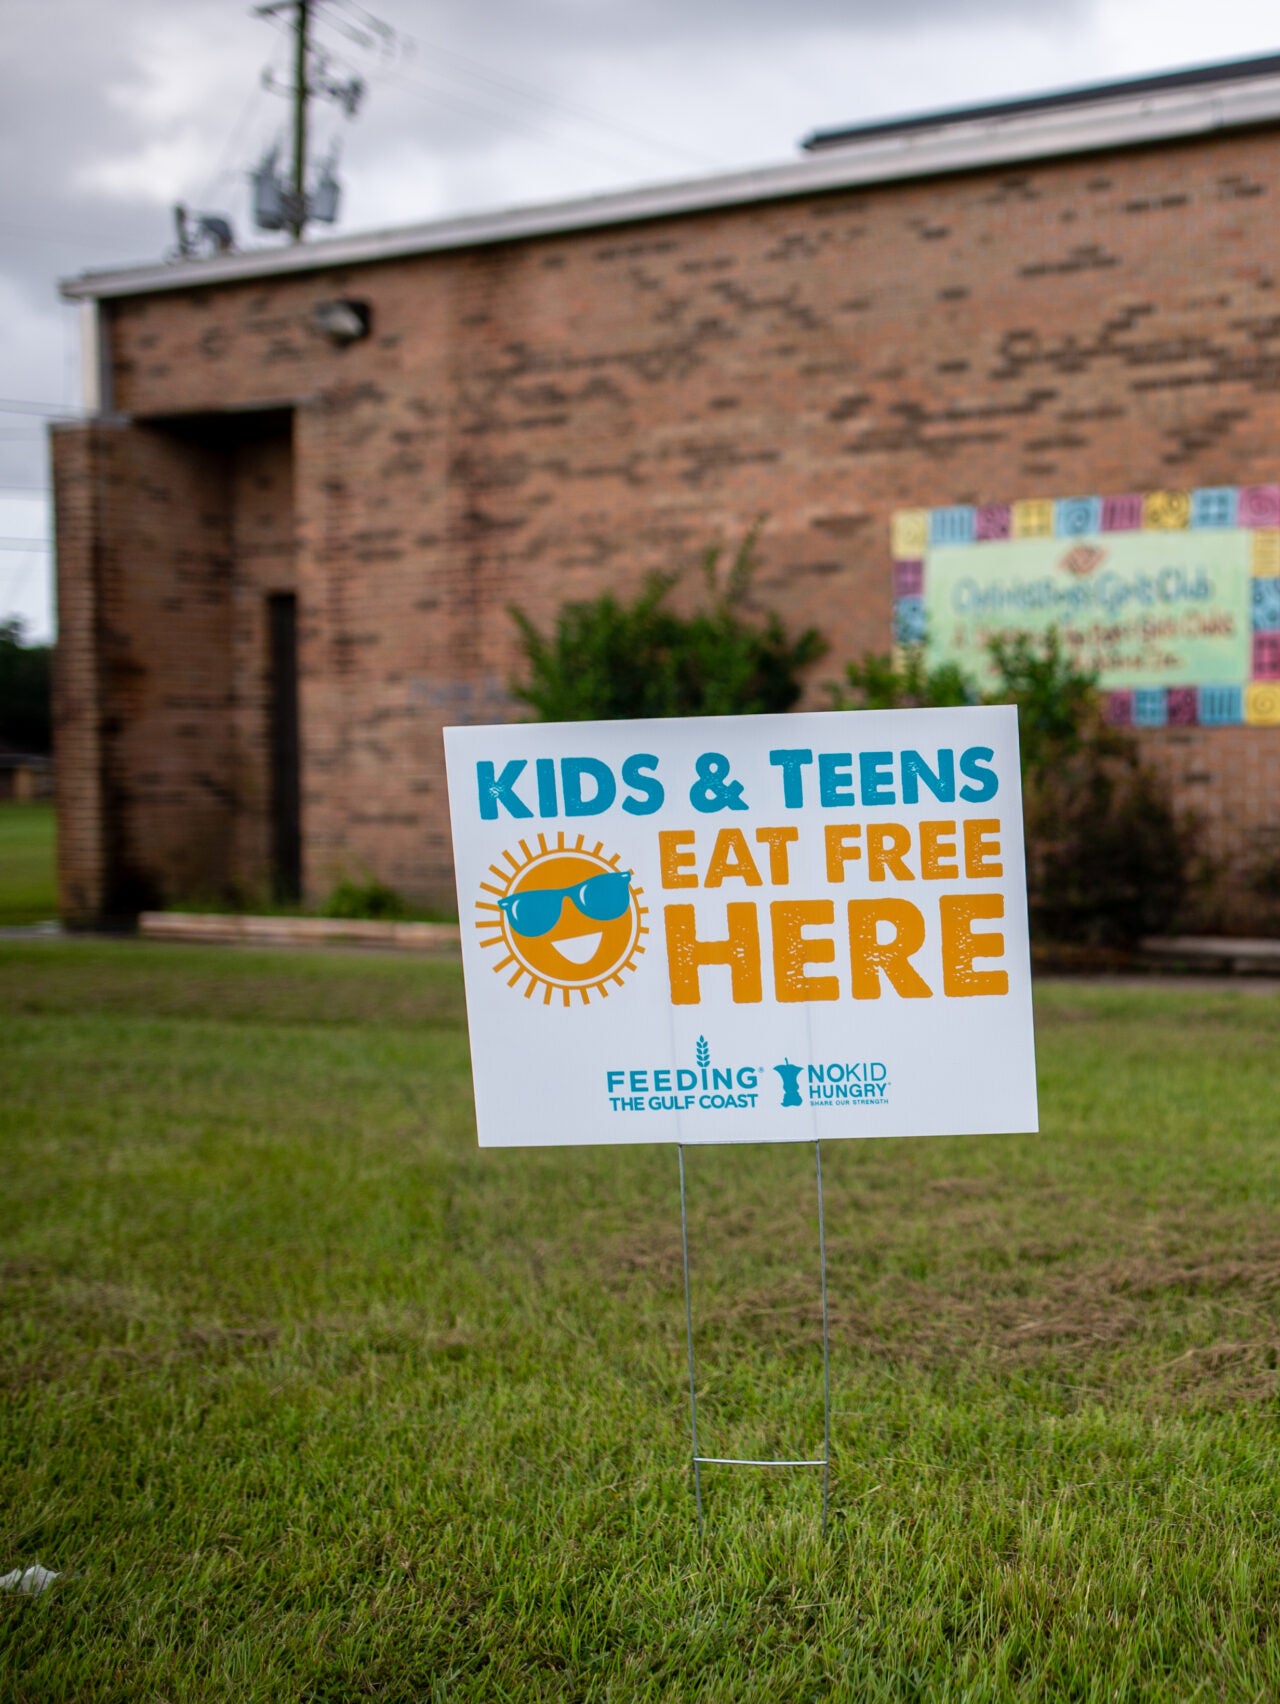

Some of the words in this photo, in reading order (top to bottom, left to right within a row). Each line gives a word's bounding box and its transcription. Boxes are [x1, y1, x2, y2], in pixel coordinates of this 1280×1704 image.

[476, 753, 665, 820] KIDS
[689, 752, 749, 813] &
[769, 746, 999, 809] TEENS
[658, 827, 799, 889] EAT
[824, 819, 1004, 883] FREE
[664, 893, 1009, 1005] HERE
[606, 1067, 758, 1093] FEEDING
[809, 1083, 887, 1099] HUNGRY
[609, 1097, 646, 1112] THE
[648, 1095, 695, 1111] GULF
[700, 1093, 759, 1109] COAST
[852, 1098, 889, 1106] STRENGTH
